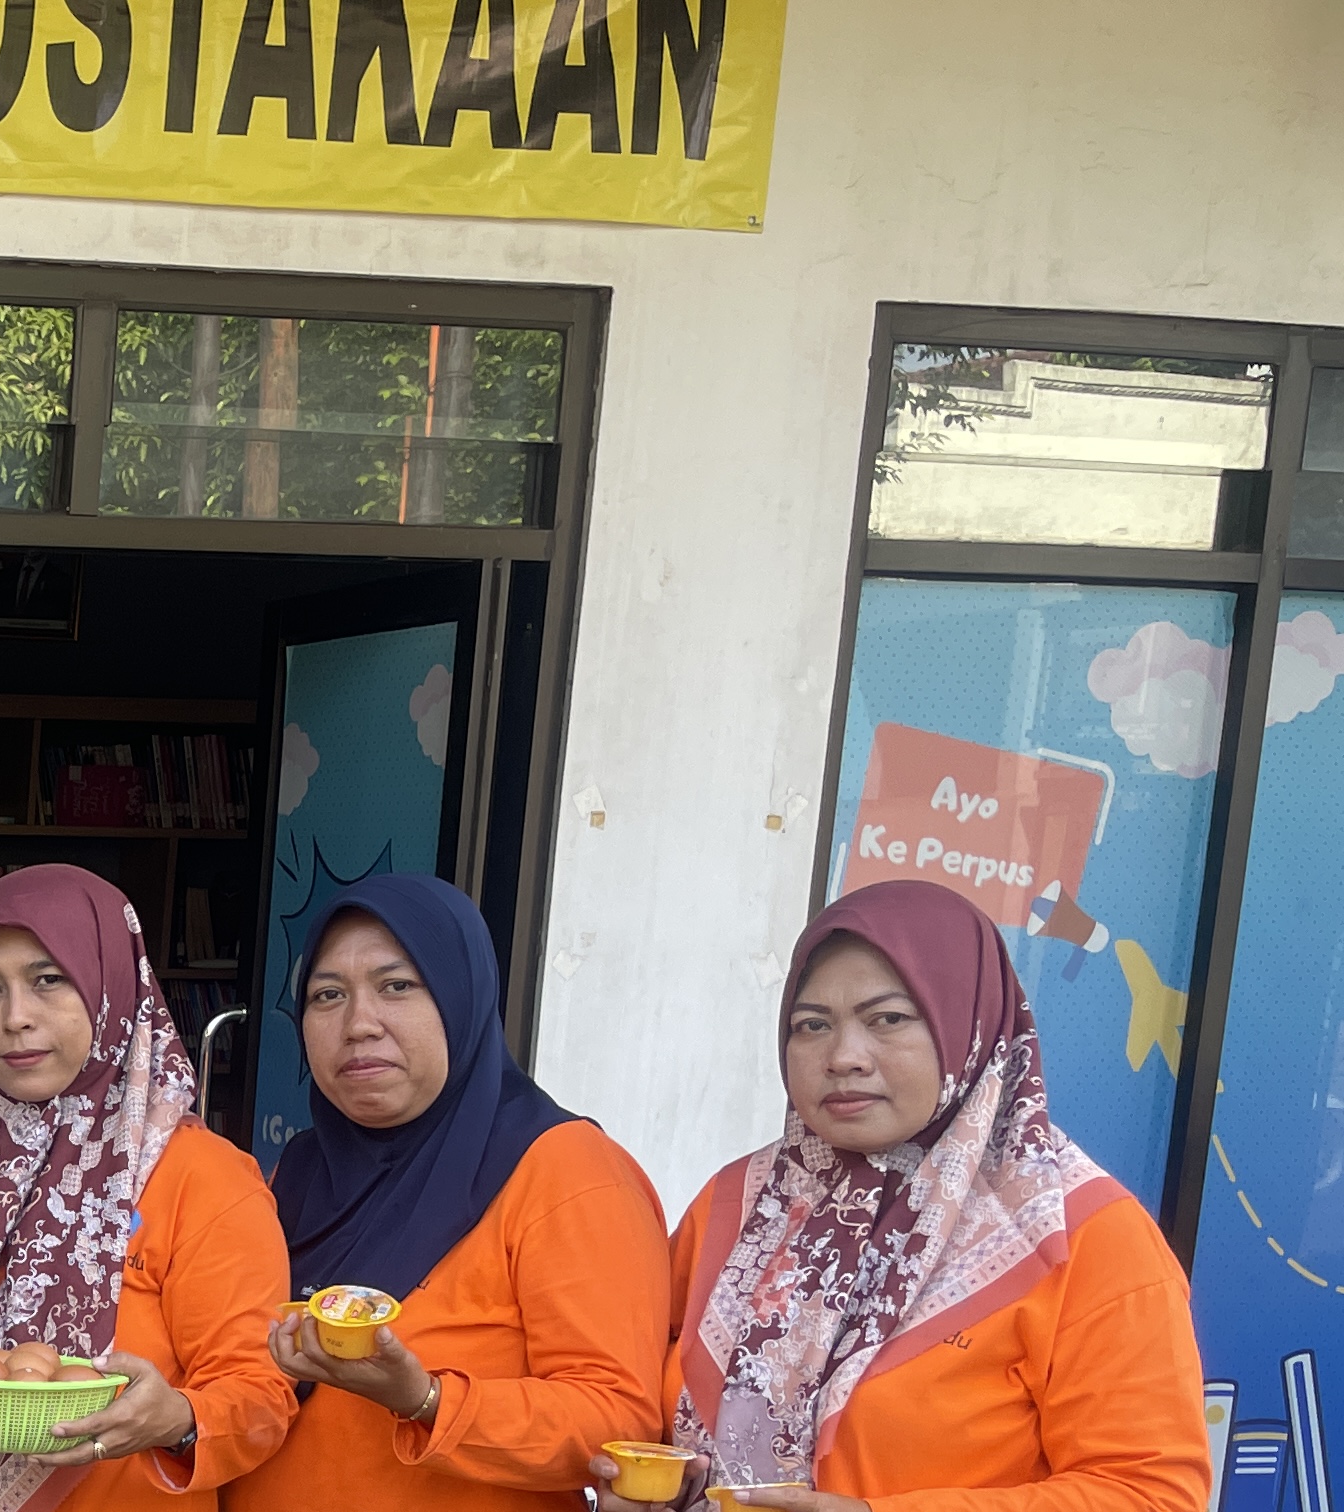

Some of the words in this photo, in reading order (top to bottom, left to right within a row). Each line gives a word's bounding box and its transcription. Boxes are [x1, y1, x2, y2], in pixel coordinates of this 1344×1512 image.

[930, 776, 999, 822] Ayo
[859, 824, 906, 864] Ke
[916, 837, 1034, 887] Perpus
